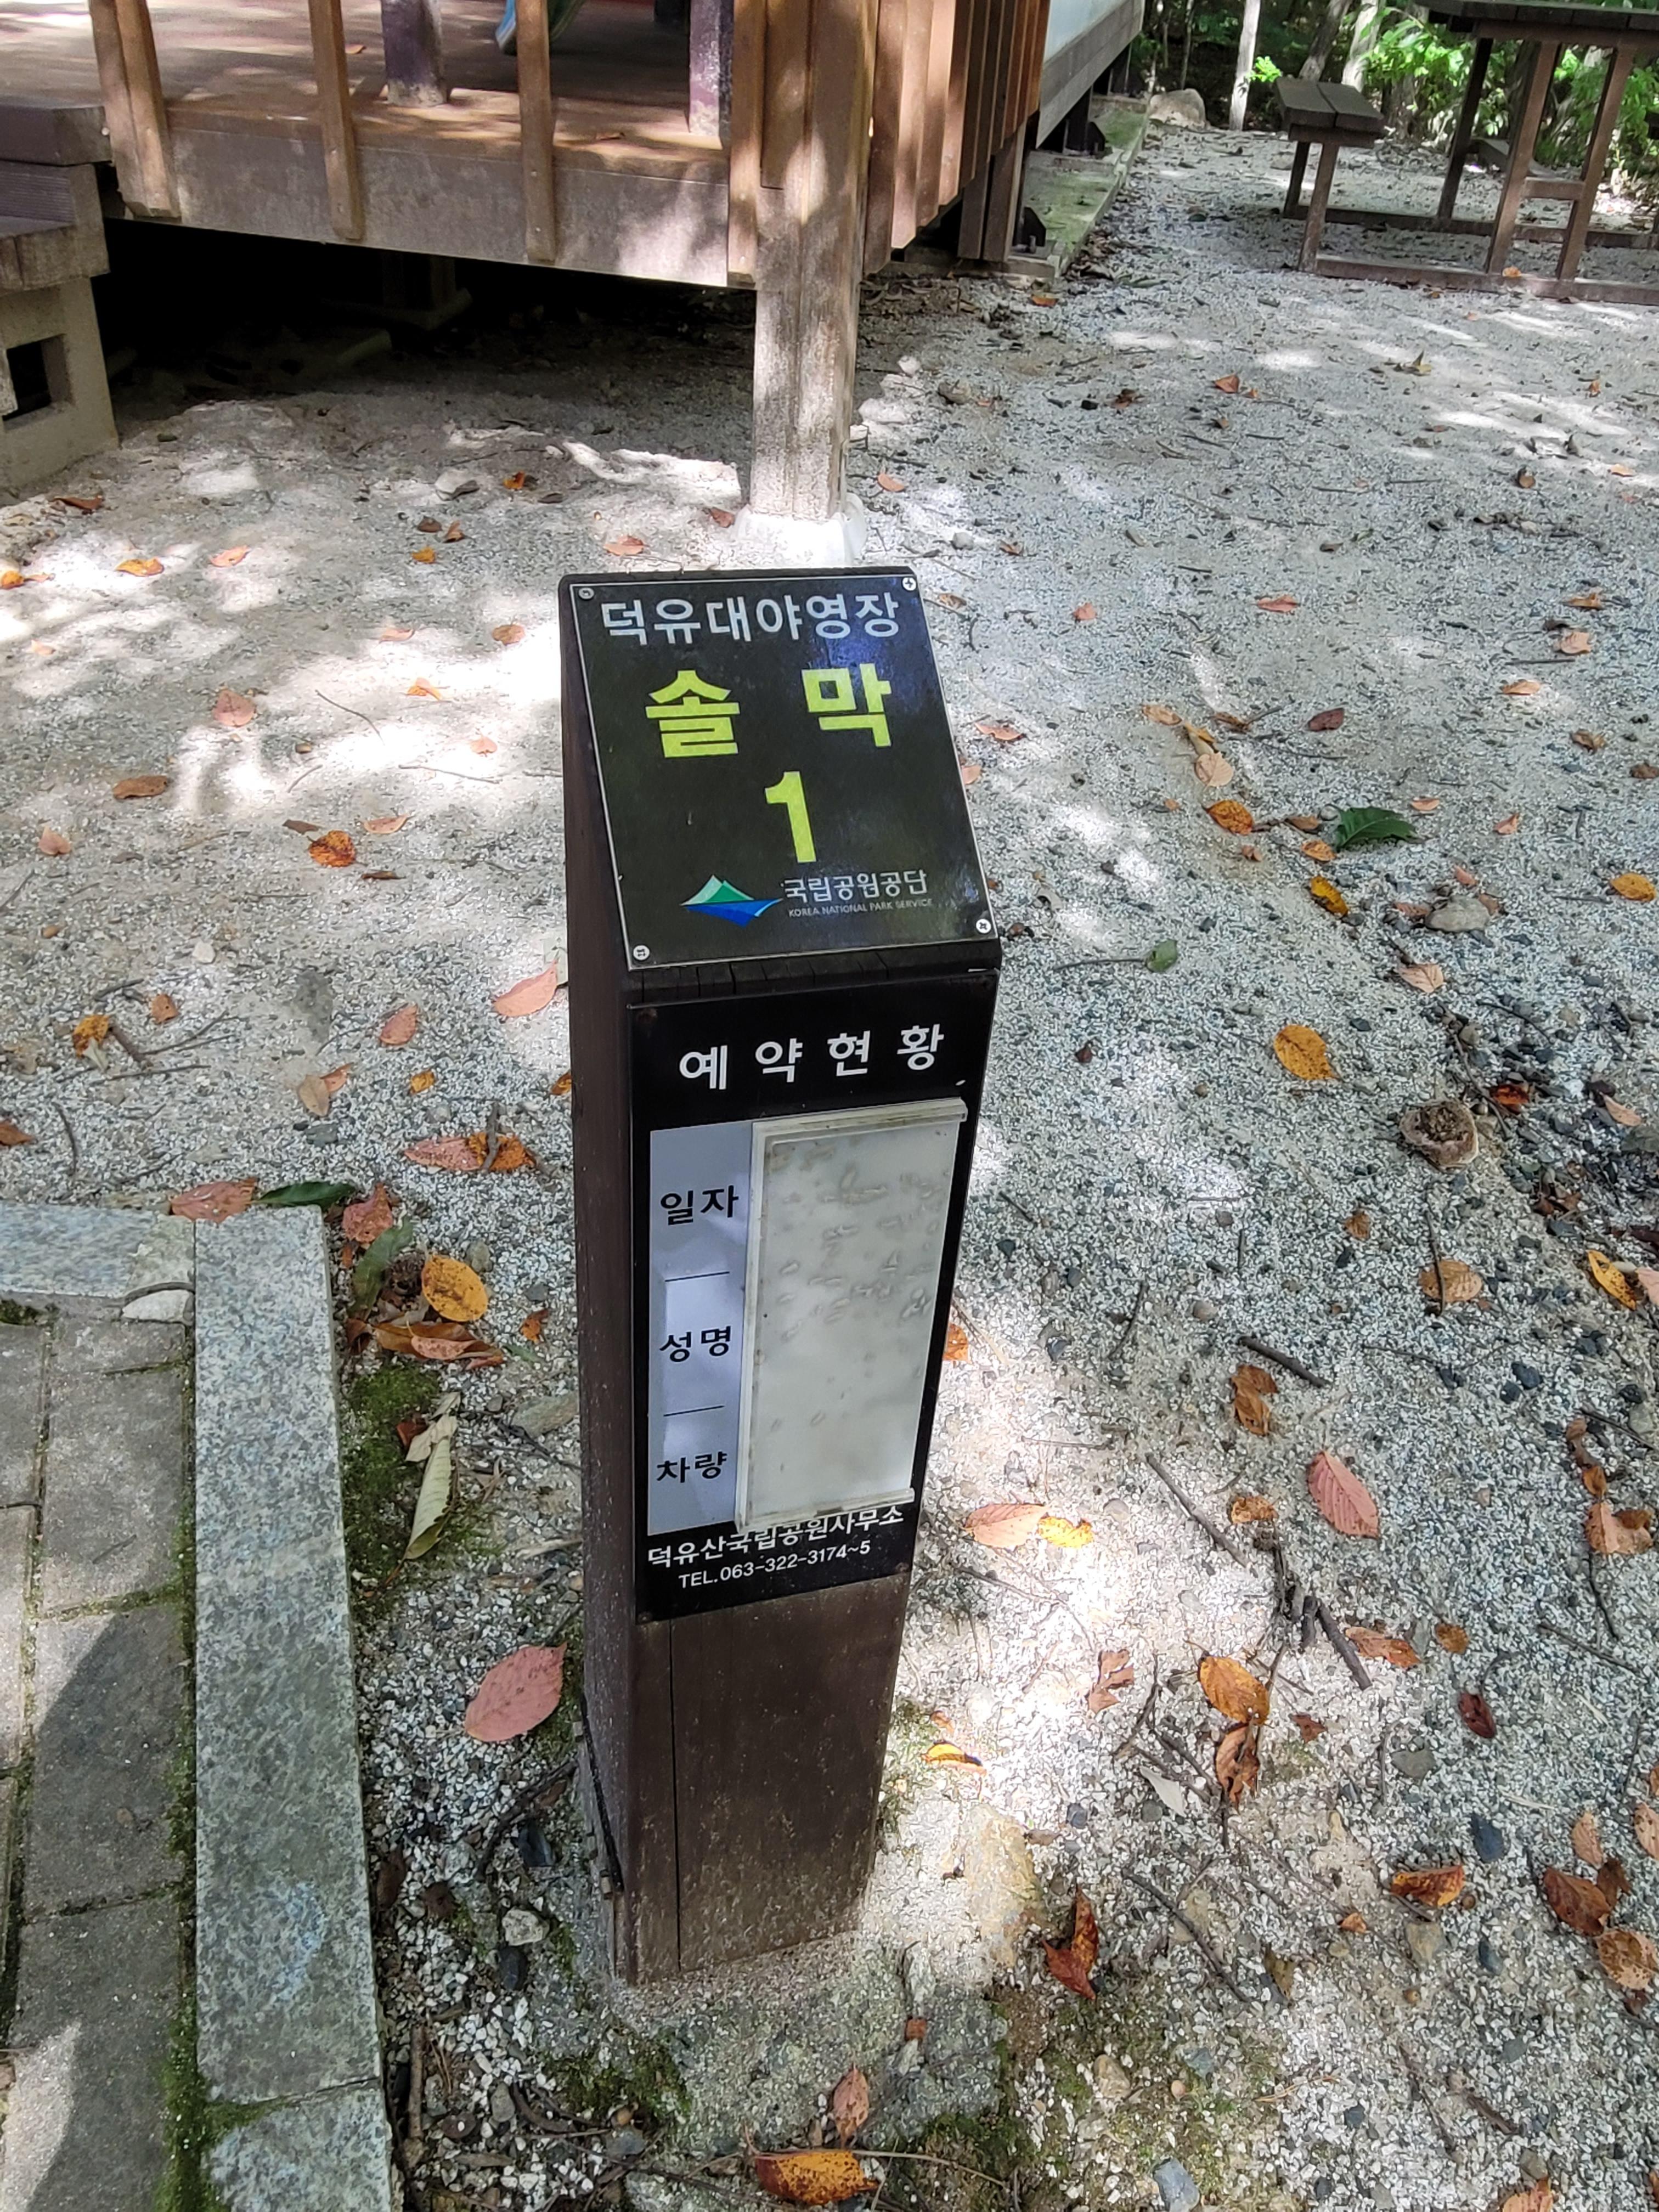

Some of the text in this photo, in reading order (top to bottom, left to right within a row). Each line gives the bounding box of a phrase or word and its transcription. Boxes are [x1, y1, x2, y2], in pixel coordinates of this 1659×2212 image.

[601, 592, 900, 646] 덕유대야영장
[765, 771, 816, 863] 1
[784, 869, 927, 904] 국립공원공단
[788, 898, 933, 917] KOREA NATIONAL PARK SERVICE
[660, 1184, 738, 1226] 일자
[659, 1325, 732, 1363] 성명
[657, 1451, 728, 1483] 차량
